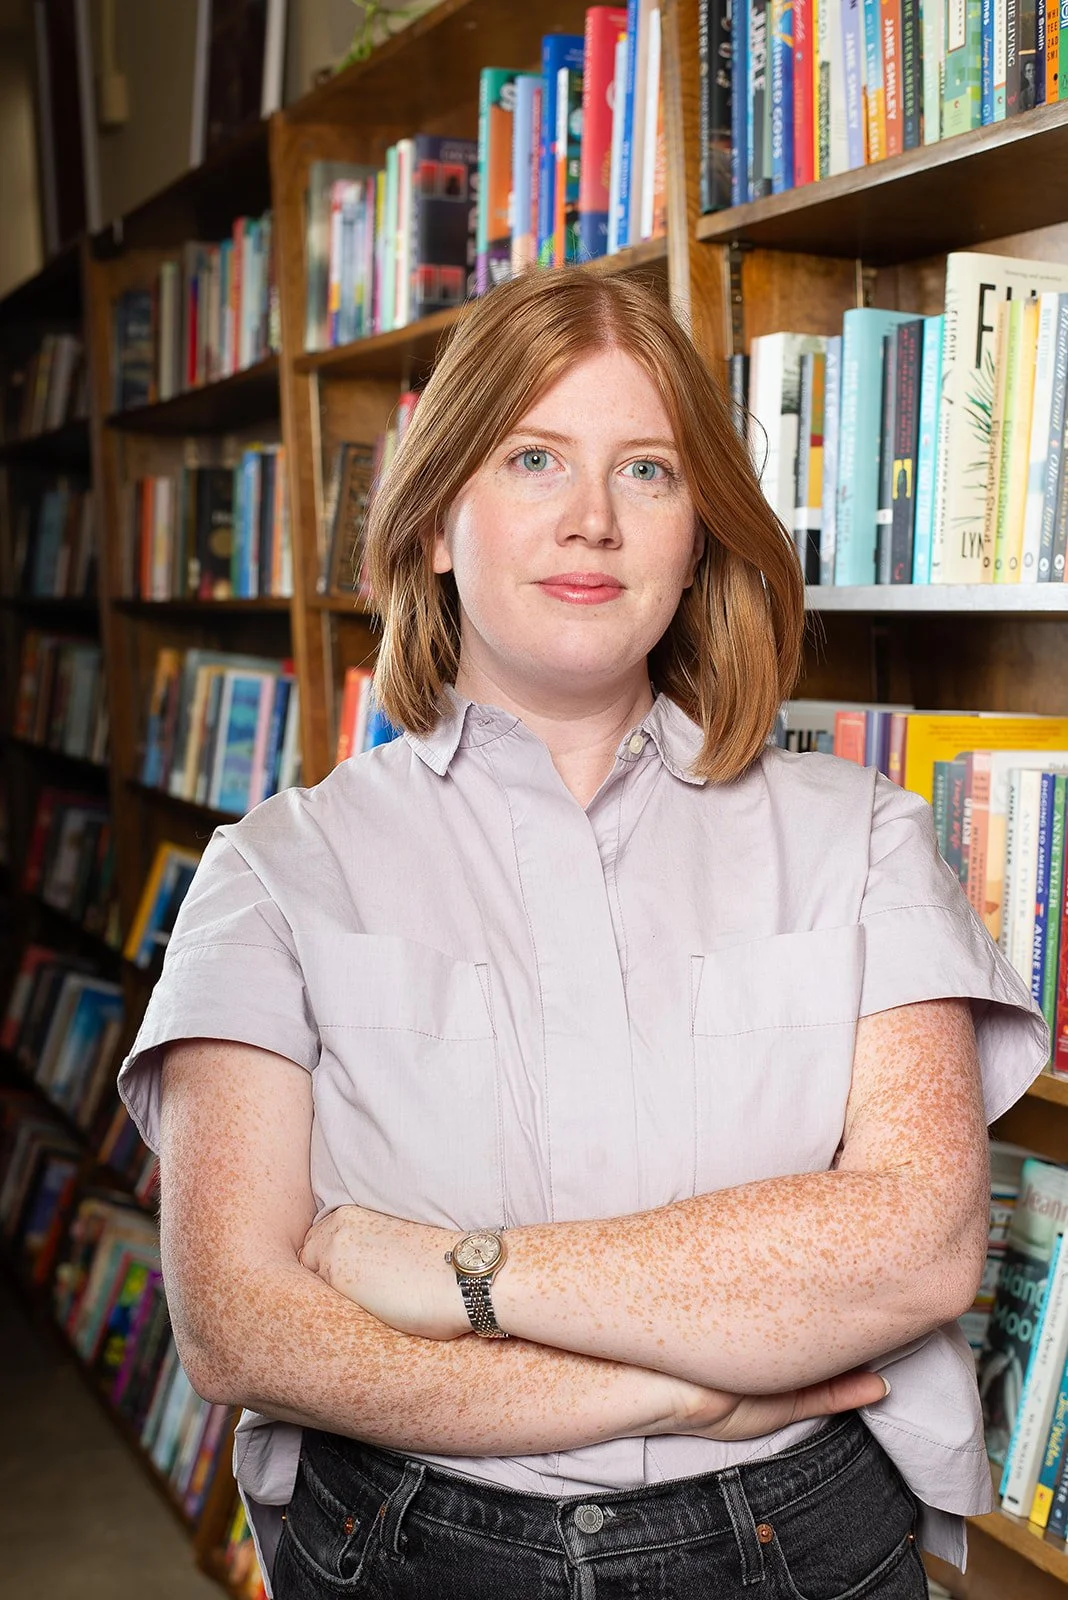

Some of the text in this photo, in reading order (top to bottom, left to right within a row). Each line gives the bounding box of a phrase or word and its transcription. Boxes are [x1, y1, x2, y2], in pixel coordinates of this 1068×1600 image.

[1007, 21, 1016, 67] LIVING
[885, 19, 898, 120] JANE SMILEY
[904, 22, 915, 117] GREENLANDERS
[847, 73, 859, 128] SMILEY
[949, 311, 958, 361] FLIGHT
[1056, 306, 1068, 380] Elizabeth
[1052, 382, 1065, 431] Strout
[986, 420, 1001, 491] Elizabeth
[996, 420, 1013, 540] Elizabeth Strout
[984, 498, 995, 543] Strout
[1040, 780, 1049, 828] DIGGING
[1022, 811, 1030, 857] ANNE
[1039, 830, 1046, 845] TO
[1051, 810, 1062, 856] ANNE
[1037, 846, 1046, 894] AMERICA
[1048, 860, 1060, 908] TYLER
[1032, 923, 1043, 970] ANNE
